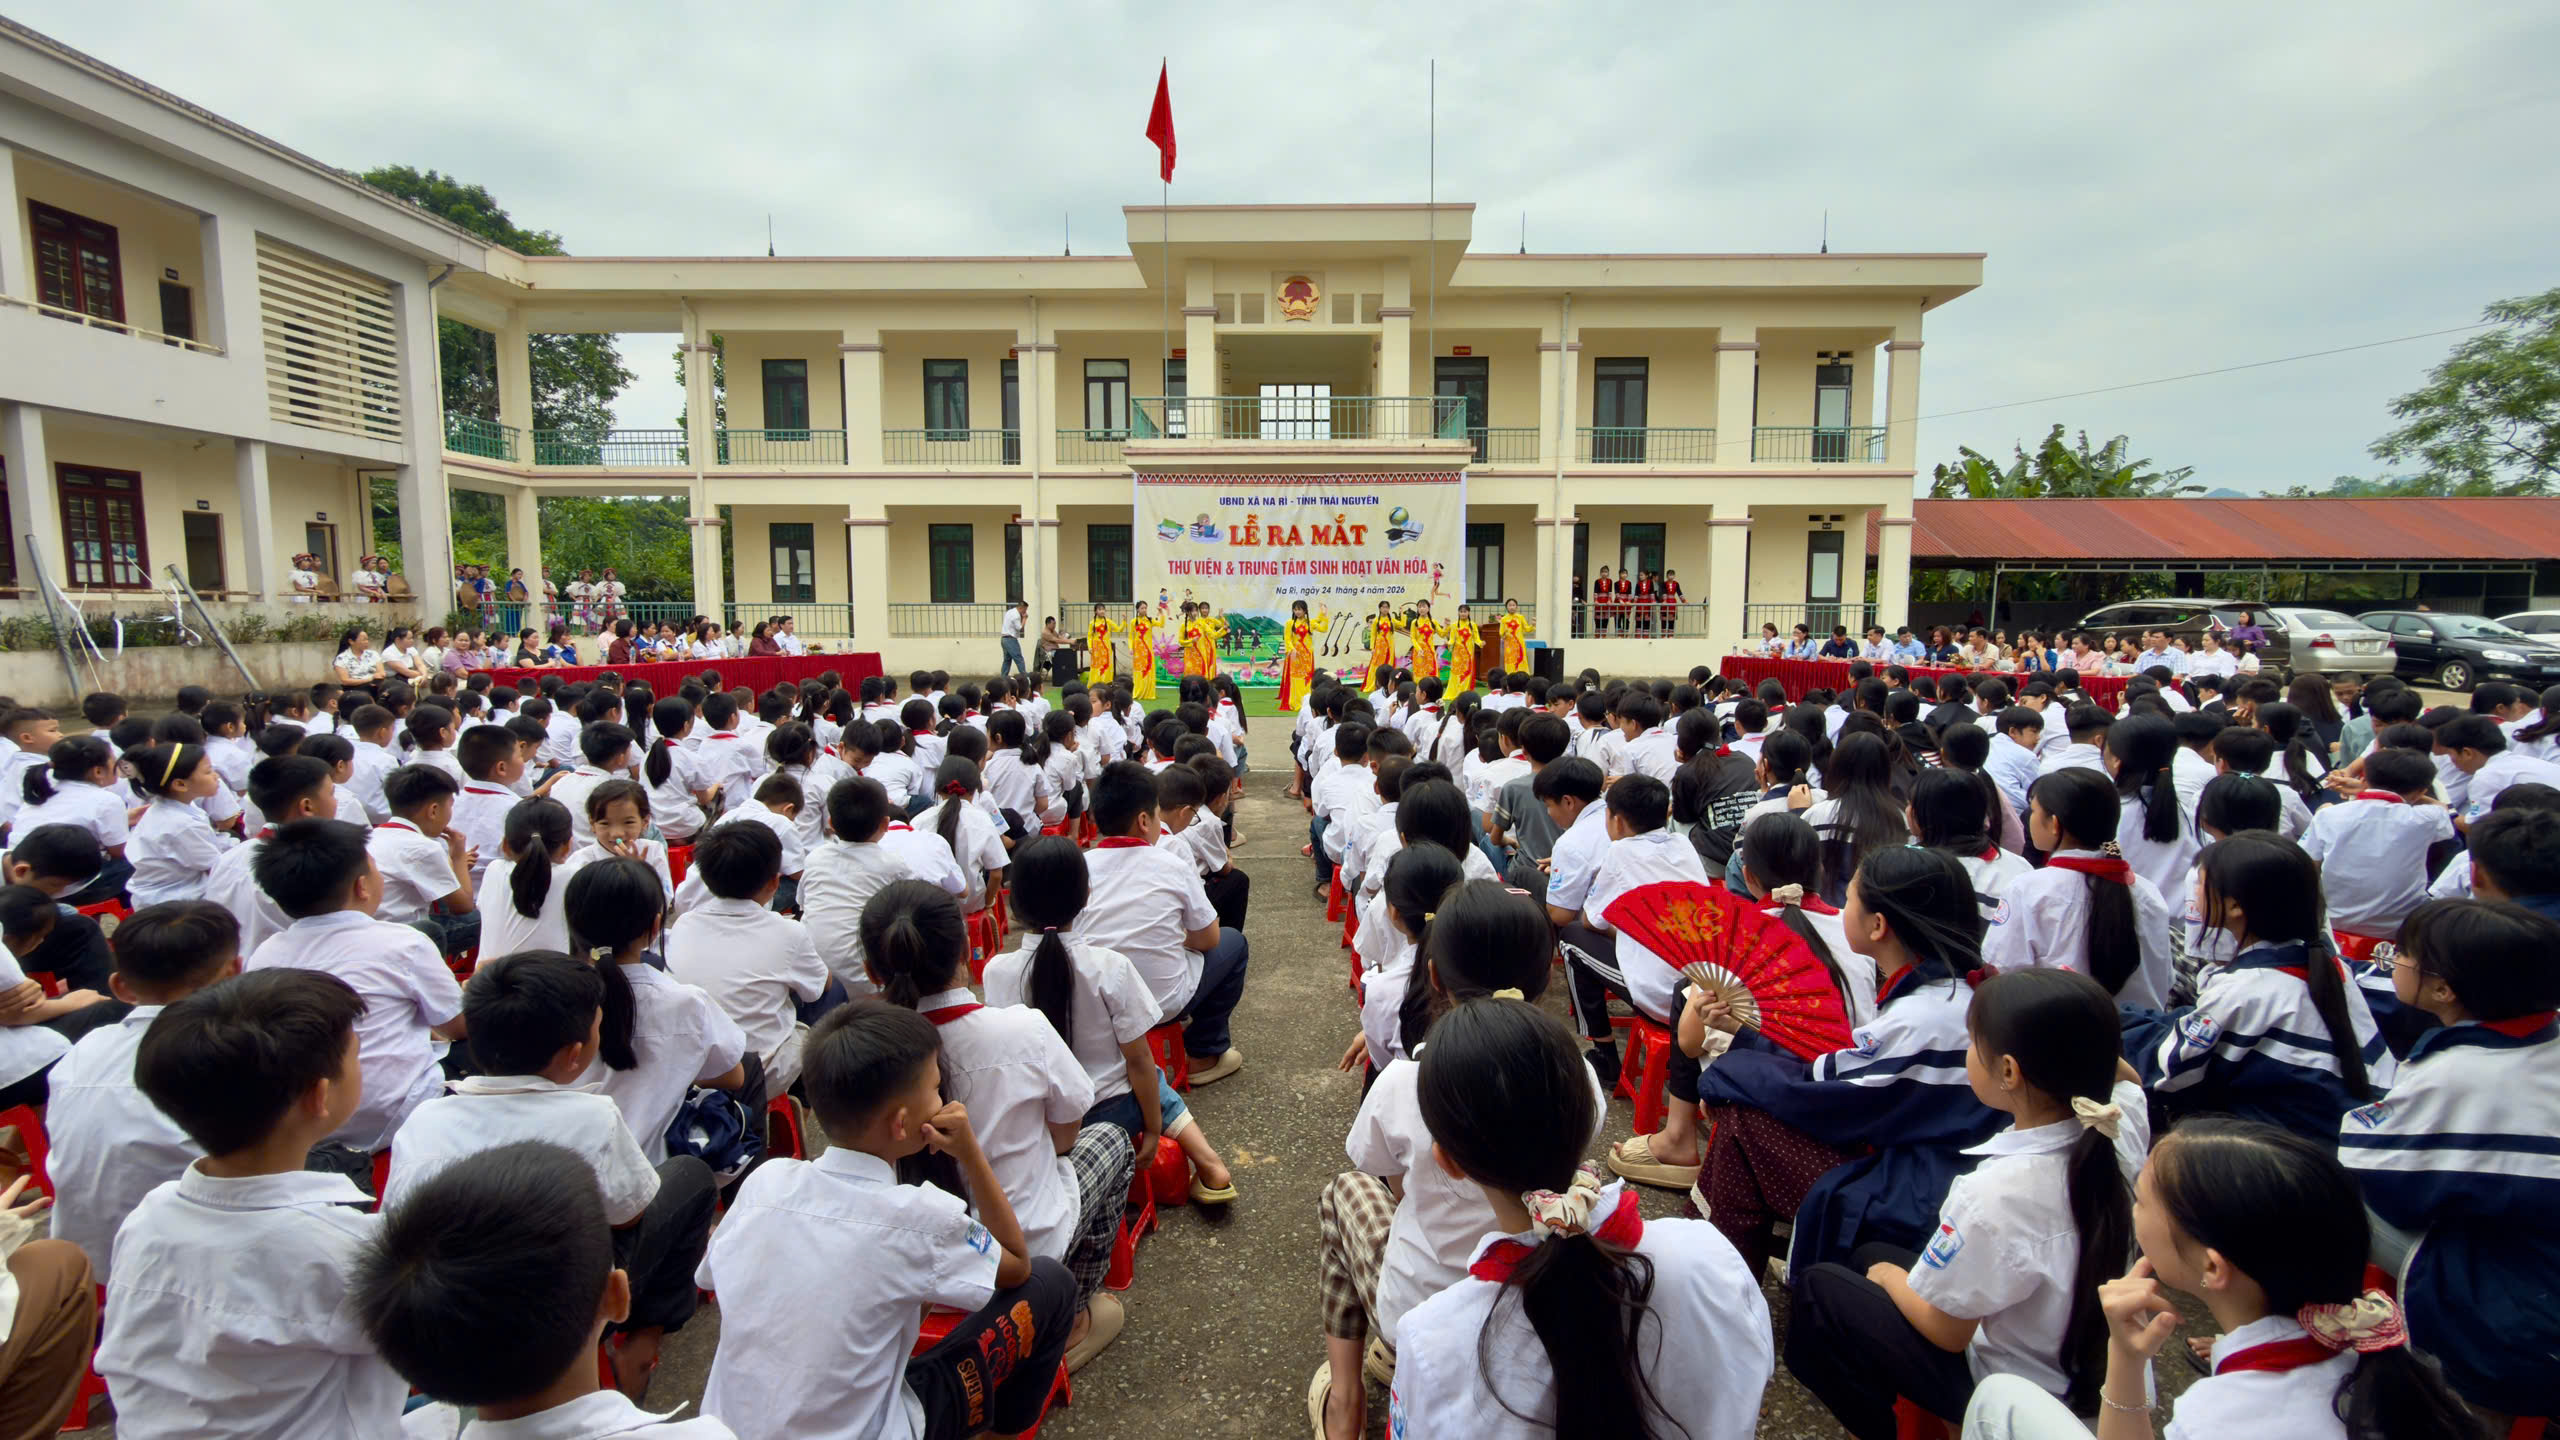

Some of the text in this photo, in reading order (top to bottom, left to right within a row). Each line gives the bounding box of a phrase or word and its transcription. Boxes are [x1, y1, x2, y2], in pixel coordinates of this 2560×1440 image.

[1219, 496, 1245, 506] UBND
[1248, 495, 1260, 506] XÃ
[1262, 496, 1276, 506] NA
[1278, 496, 1288, 506] RÌ
[1319, 495, 1339, 506] THÁI
[1341, 495, 1379, 505] NGUYÊN
[1228, 513, 1368, 547] LỄ RA MẮT
[1167, 556, 1428, 579] THƯ VIỆN & TRUNG TÂM SINH HOẠT VĂN HÓA
[1276, 586, 1287, 595] Na
[1300, 587, 1320, 596] ngày
[1321, 586, 1332, 594] 24
[1335, 586, 1358, 596] tháng
[1360, 586, 1365, 594] 4
[1386, 586, 1406, 594] 2026
